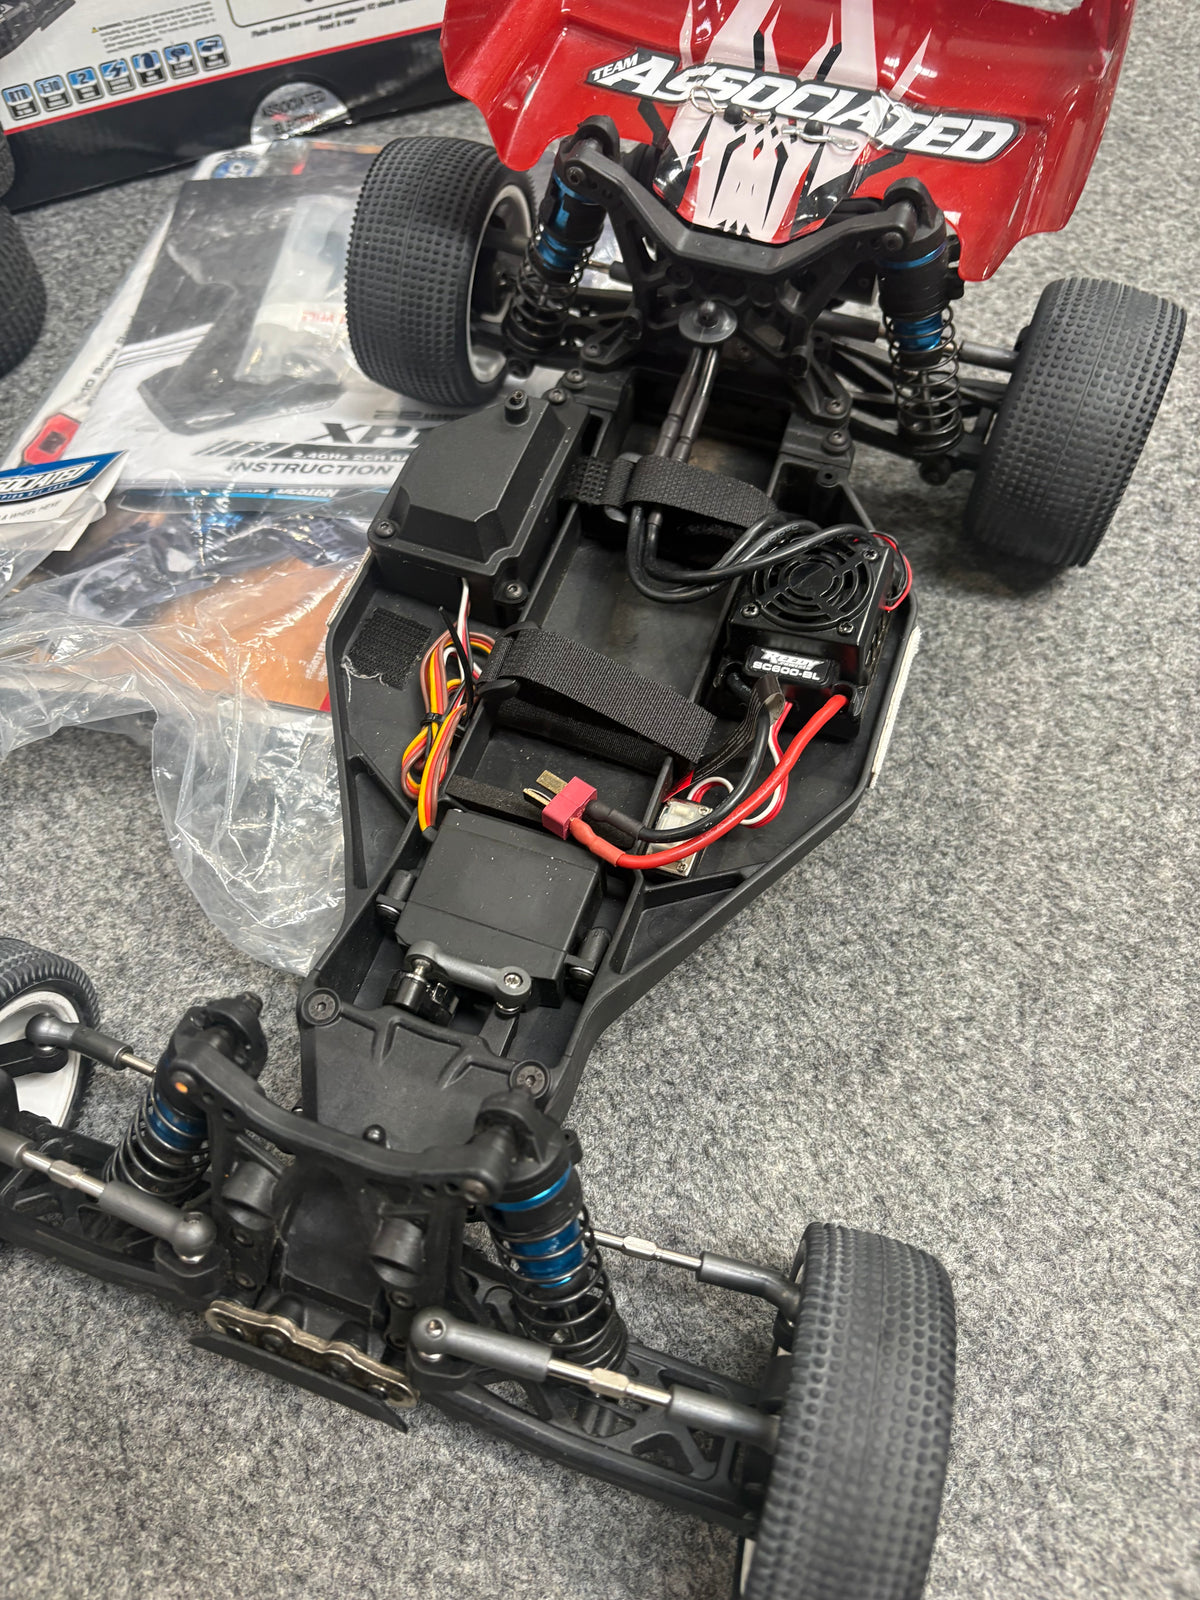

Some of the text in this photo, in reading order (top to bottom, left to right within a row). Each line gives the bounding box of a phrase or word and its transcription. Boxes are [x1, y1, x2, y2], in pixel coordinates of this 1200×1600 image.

[591, 52, 640, 81] TEAM
[78, 72, 89, 85] 2
[596, 55, 1015, 161] ASSOCIATED
[291, 451, 350, 462] 2.4GHz
[353, 453, 387, 462] 2CH
[225, 460, 394, 477] INSTRUCTION
